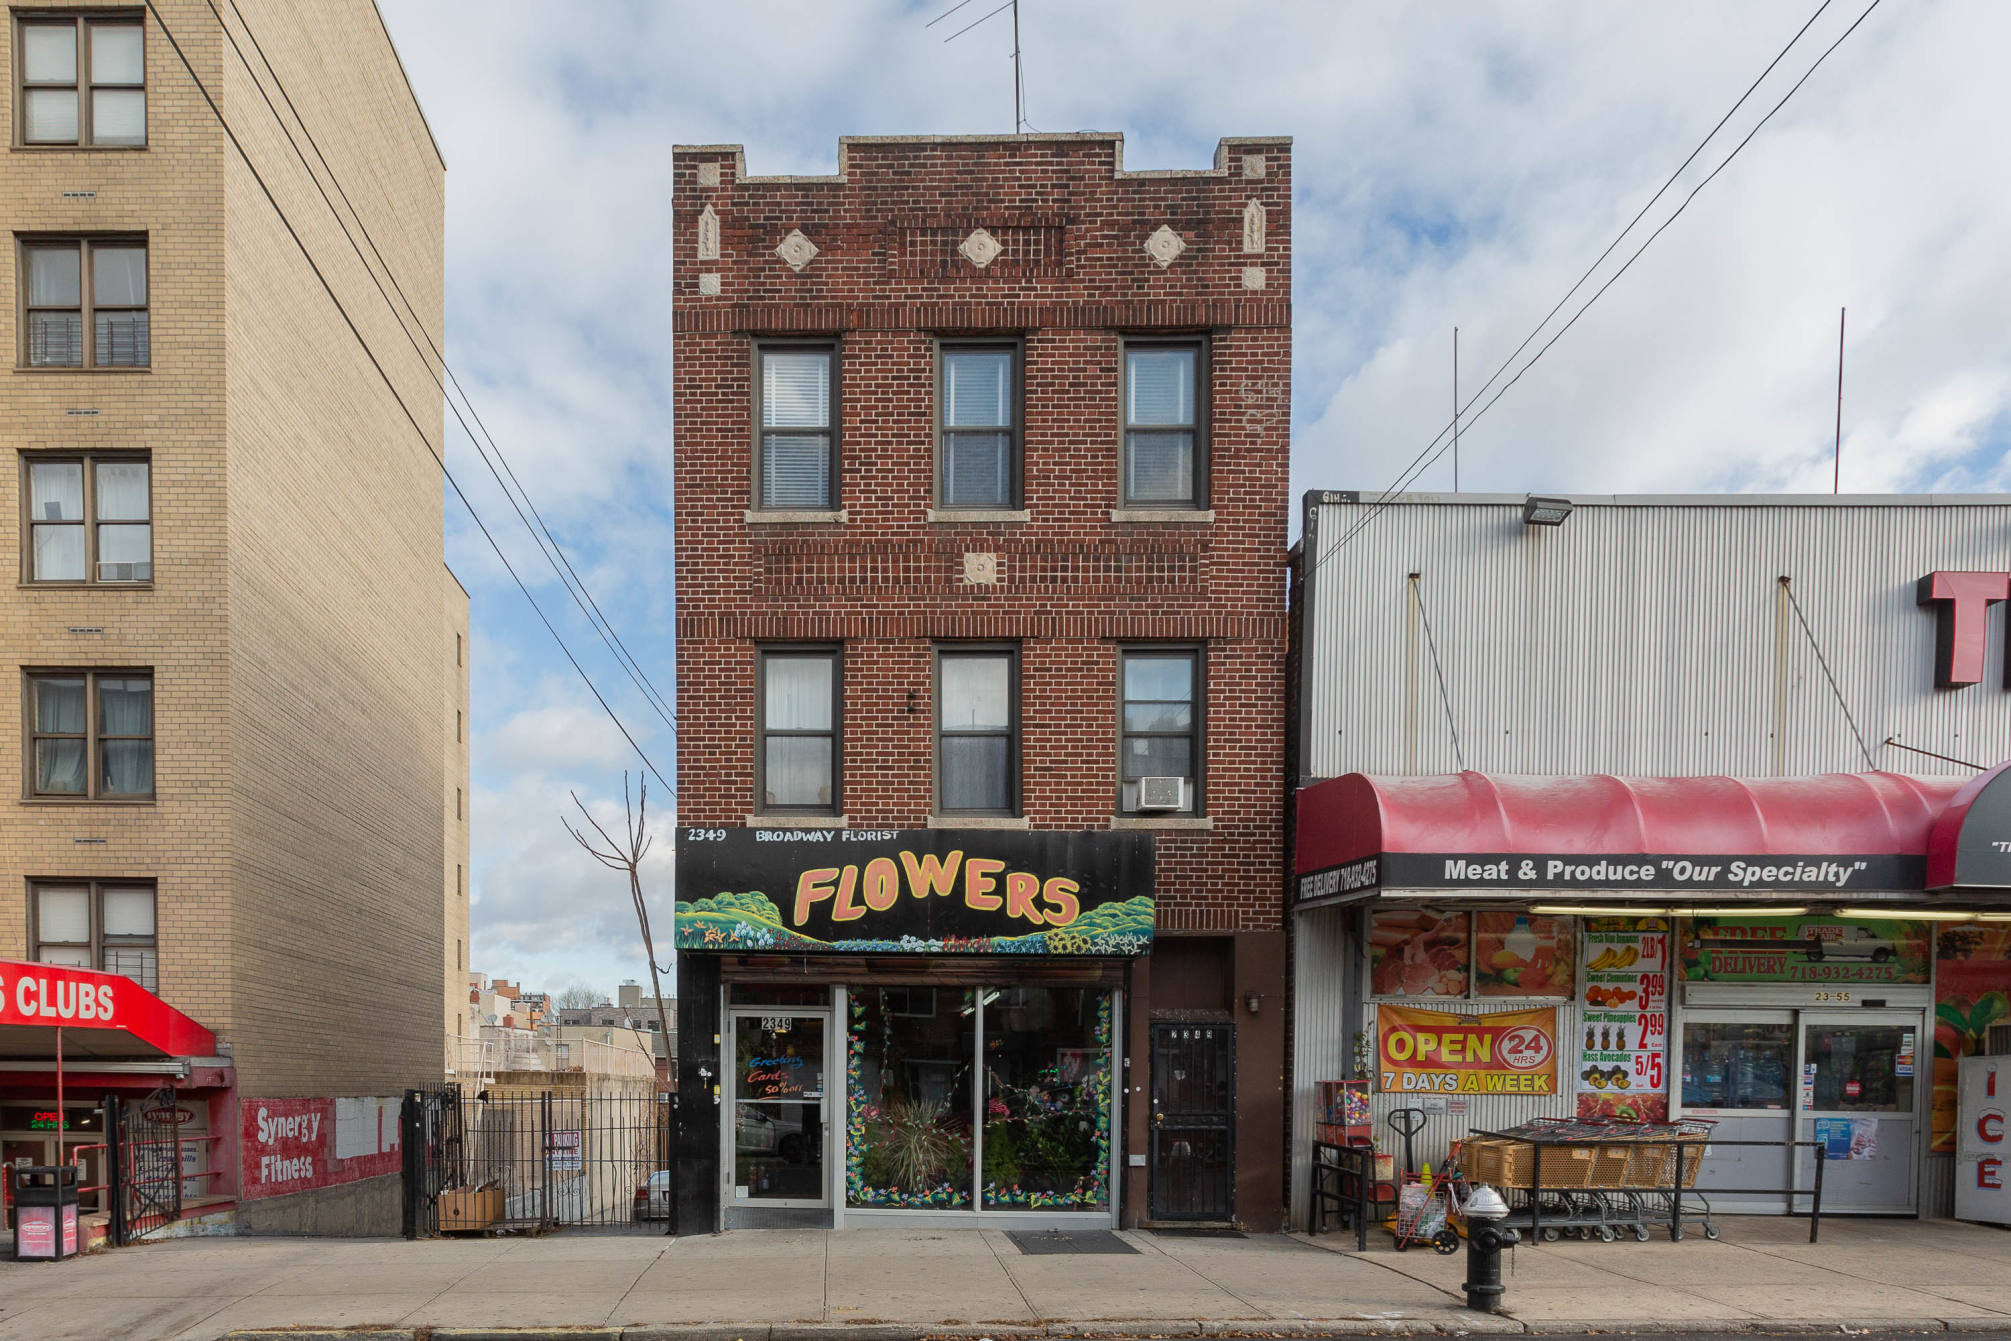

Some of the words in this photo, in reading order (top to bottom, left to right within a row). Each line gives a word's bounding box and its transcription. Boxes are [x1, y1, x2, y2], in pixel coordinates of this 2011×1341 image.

[688, 828, 727, 841] 2349
[755, 830, 835, 842] BROADWAY
[842, 830, 899, 841] FLORIST
[1300, 876, 1313, 900] FREE
[1314, 870, 1340, 896] DELIVERY
[1340, 860, 1377, 891] 718-932-4275
[1444, 859, 1509, 880] Meat
[1517, 859, 1538, 880] &
[1546, 860, 1656, 881] Produce
[1661, 860, 1722, 882] "Our
[1727, 860, 1868, 887] Specialty"
[793, 850, 1080, 927] FLOWERS
[1711, 956, 1788, 974] DELIVERY
[1790, 965, 1895, 980] 718-932-4275
[16, 976, 115, 1021] CLUBS
[1815, 992, 1850, 1002] 23-55
[762, 1017, 791, 1030] 2349
[1583, 1012, 1602, 1023] Sweet
[1386, 1031, 1493, 1064] OPEN
[1507, 1034, 1543, 1055] 24
[1512, 1055, 1536, 1064] HRS
[1383, 1072, 1397, 1090] 7
[1402, 1072, 1459, 1092] DAYS
[1463, 1072, 1480, 1092] A
[1485, 1073, 1551, 1092] WEEK
[47, 1119, 70, 1129] HS
[257, 1106, 321, 1146] Synergy
[260, 1154, 313, 1184] Fitness
